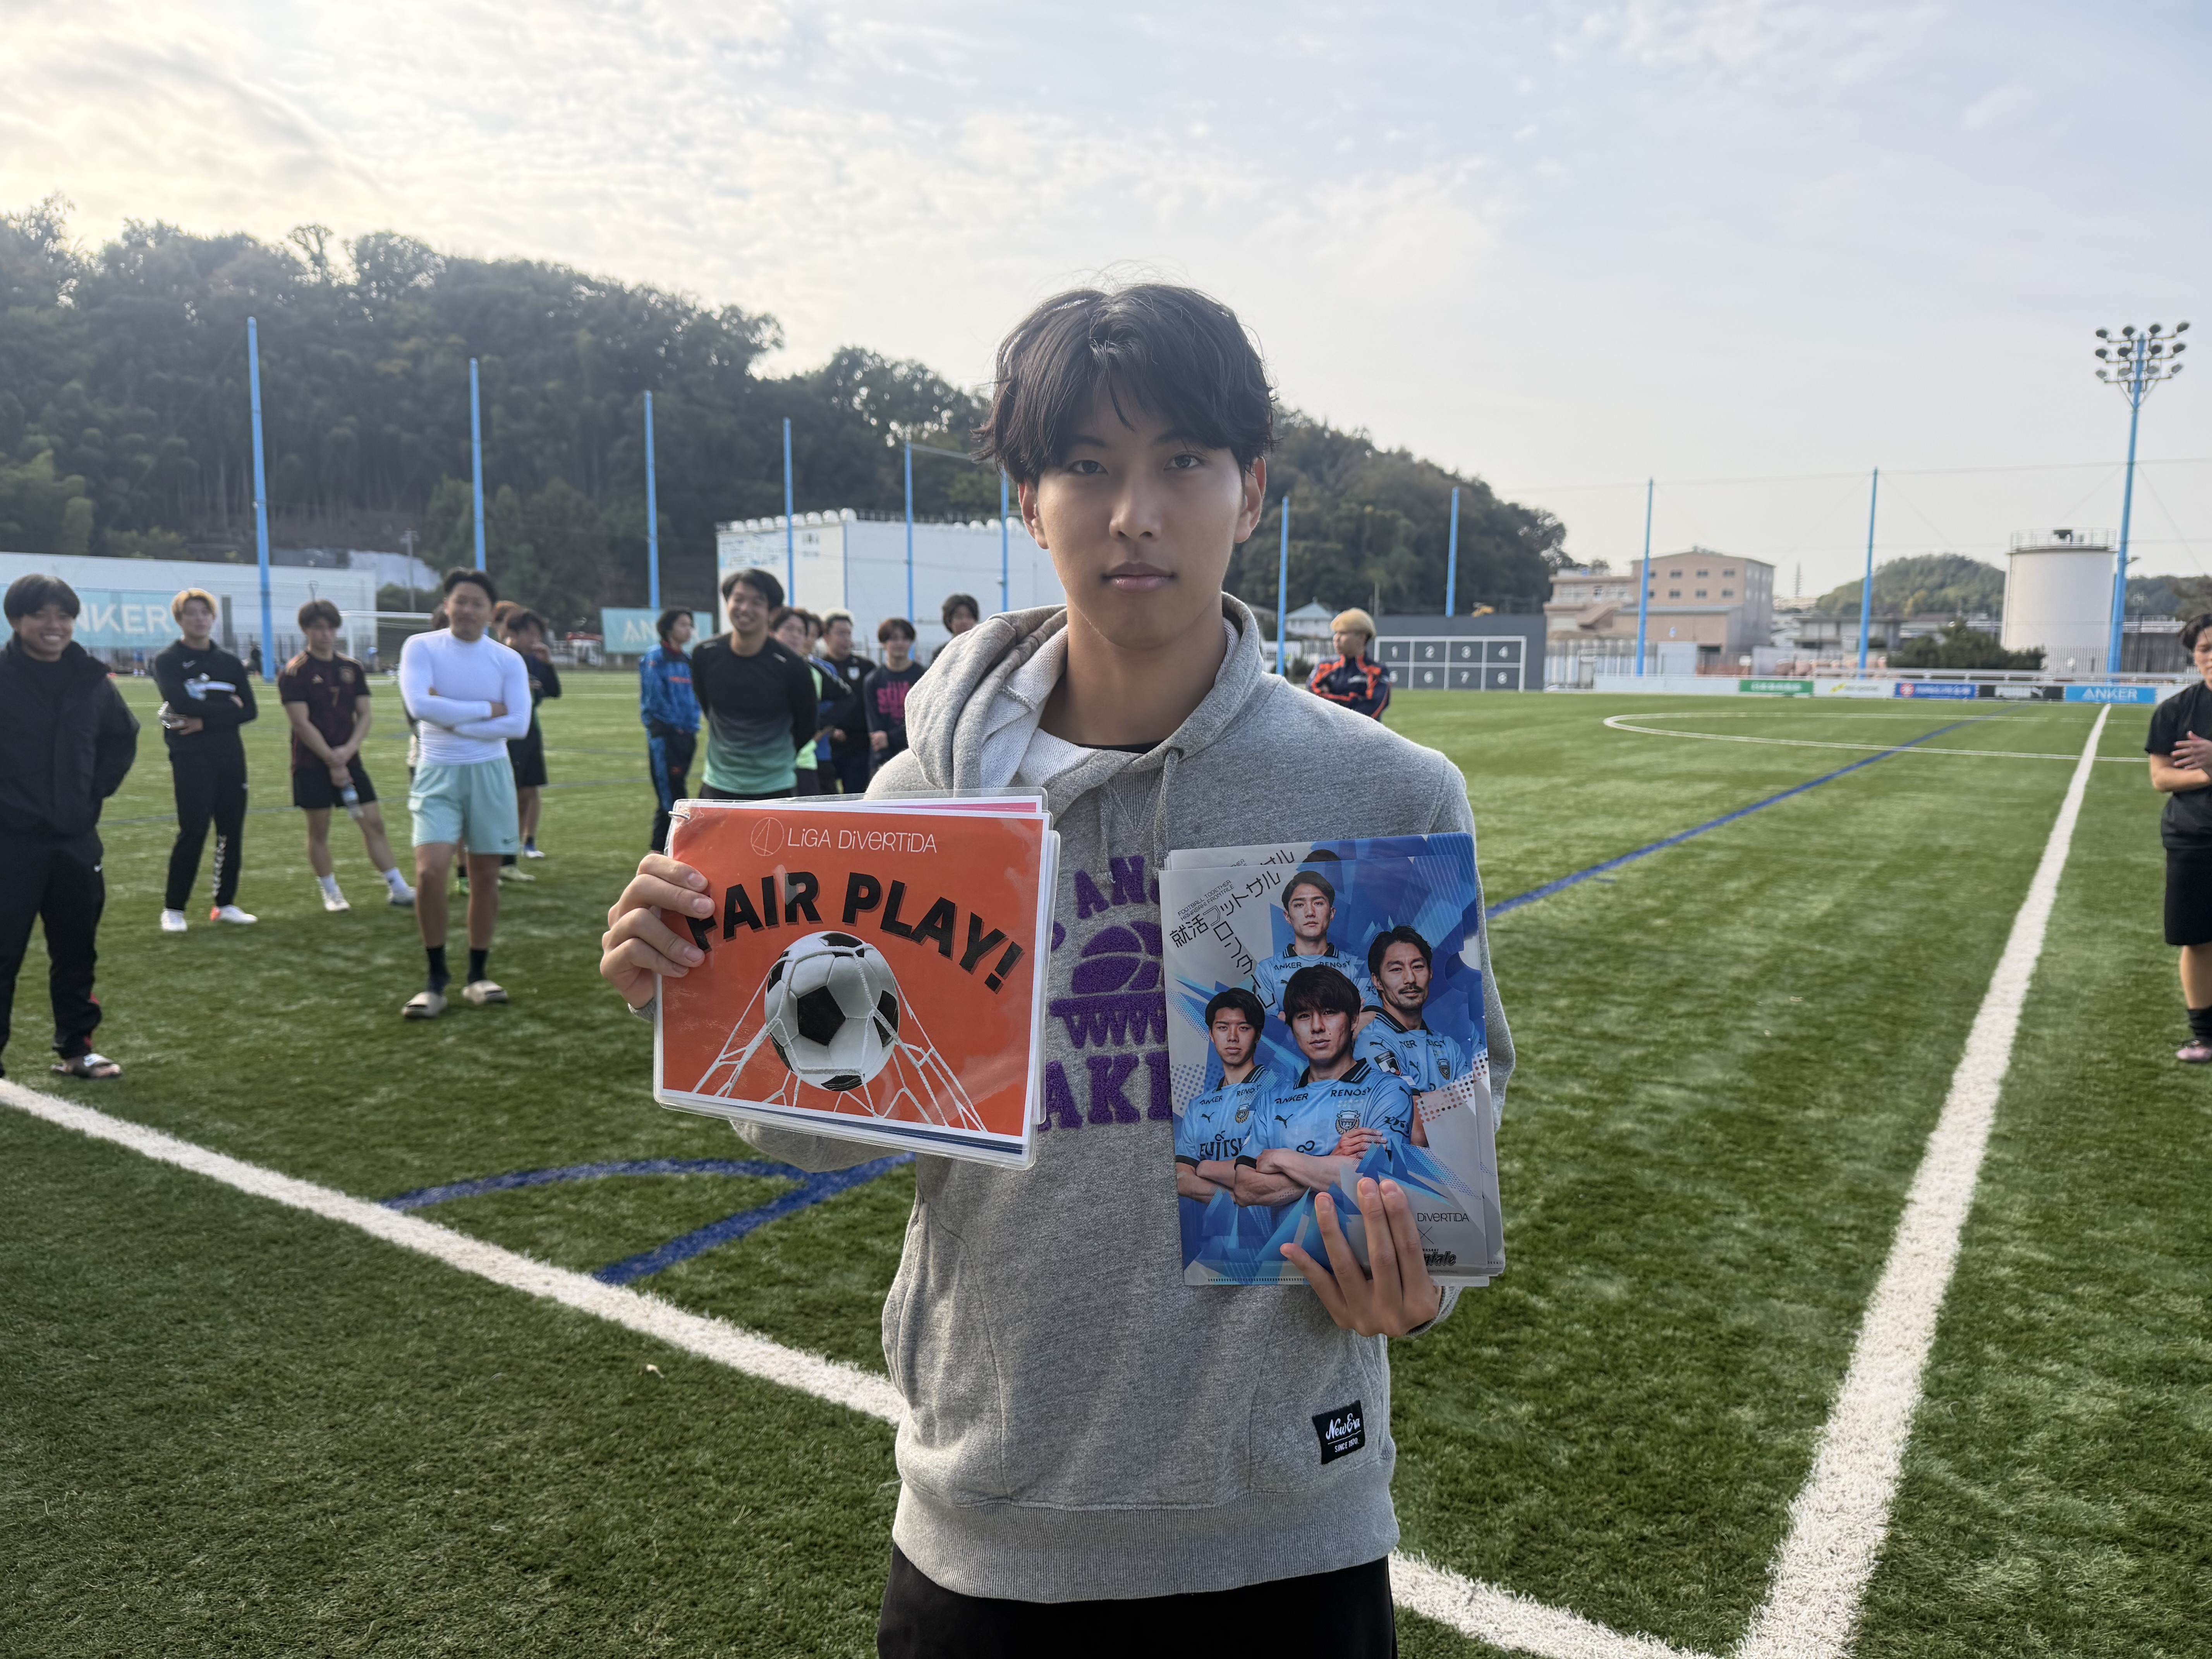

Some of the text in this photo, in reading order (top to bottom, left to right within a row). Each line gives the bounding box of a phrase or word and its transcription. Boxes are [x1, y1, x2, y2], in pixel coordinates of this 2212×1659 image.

[76, 603, 172, 634] NKER
[1391, 645, 1398, 658] 1
[1425, 645, 1435, 659] 2
[1460, 671, 1470, 684] 7
[2082, 687, 2138, 701] ANKER
[1178, 879, 1231, 916] FOOTBALL TOGETHER
[1207, 884, 1234, 904] FRONTALE
[842, 872, 1025, 994] PLAY!
[1273, 962, 1302, 970] ANKER
[1274, 1087, 1372, 1104] ANKER RENOSY
[1424, 1251, 1456, 1266] ntale
[1334, 1441, 1348, 1453] SINCE
